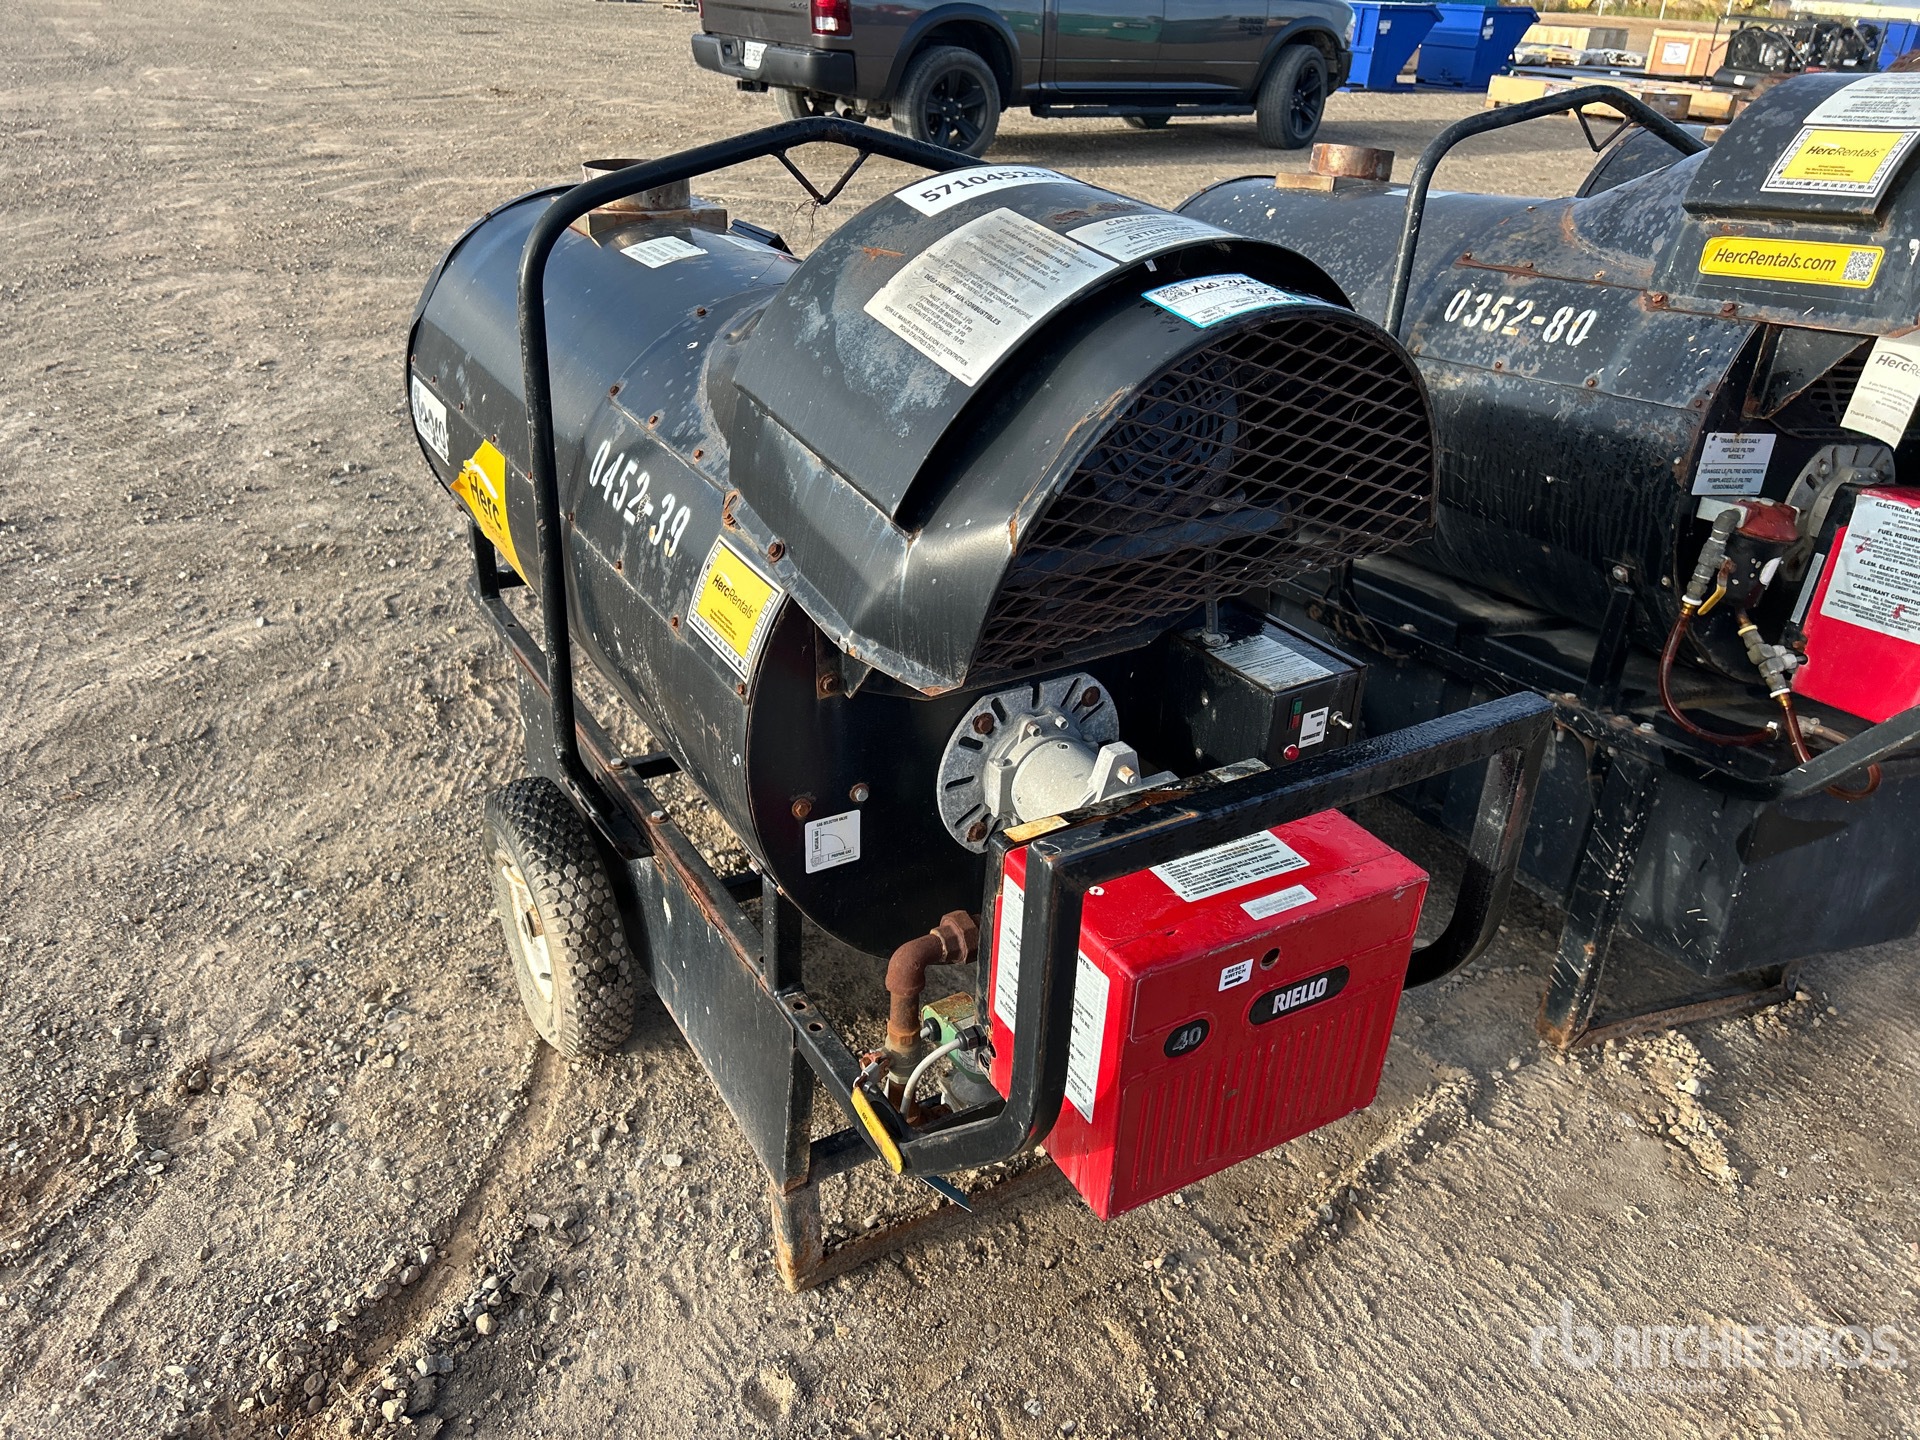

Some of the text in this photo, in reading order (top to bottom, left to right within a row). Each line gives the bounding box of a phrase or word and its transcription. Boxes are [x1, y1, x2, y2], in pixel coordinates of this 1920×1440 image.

[1806, 145, 1880, 158] HercRentals
[1712, 248, 1837, 272] HercRentals.com
[952, 293, 966, 302] AUX
[1444, 288, 1597, 346] 0352-80
[468, 474, 502, 531] Herc
[590, 440, 690, 558] 0452-39
[1875, 501, 1912, 514] ELECTRICAL
[712, 574, 754, 619] HercRentals
[1852, 583, 1889, 596] CARBURANT
[1272, 978, 1328, 1014] RIELLO
[1172, 1027, 1202, 1050] 40
